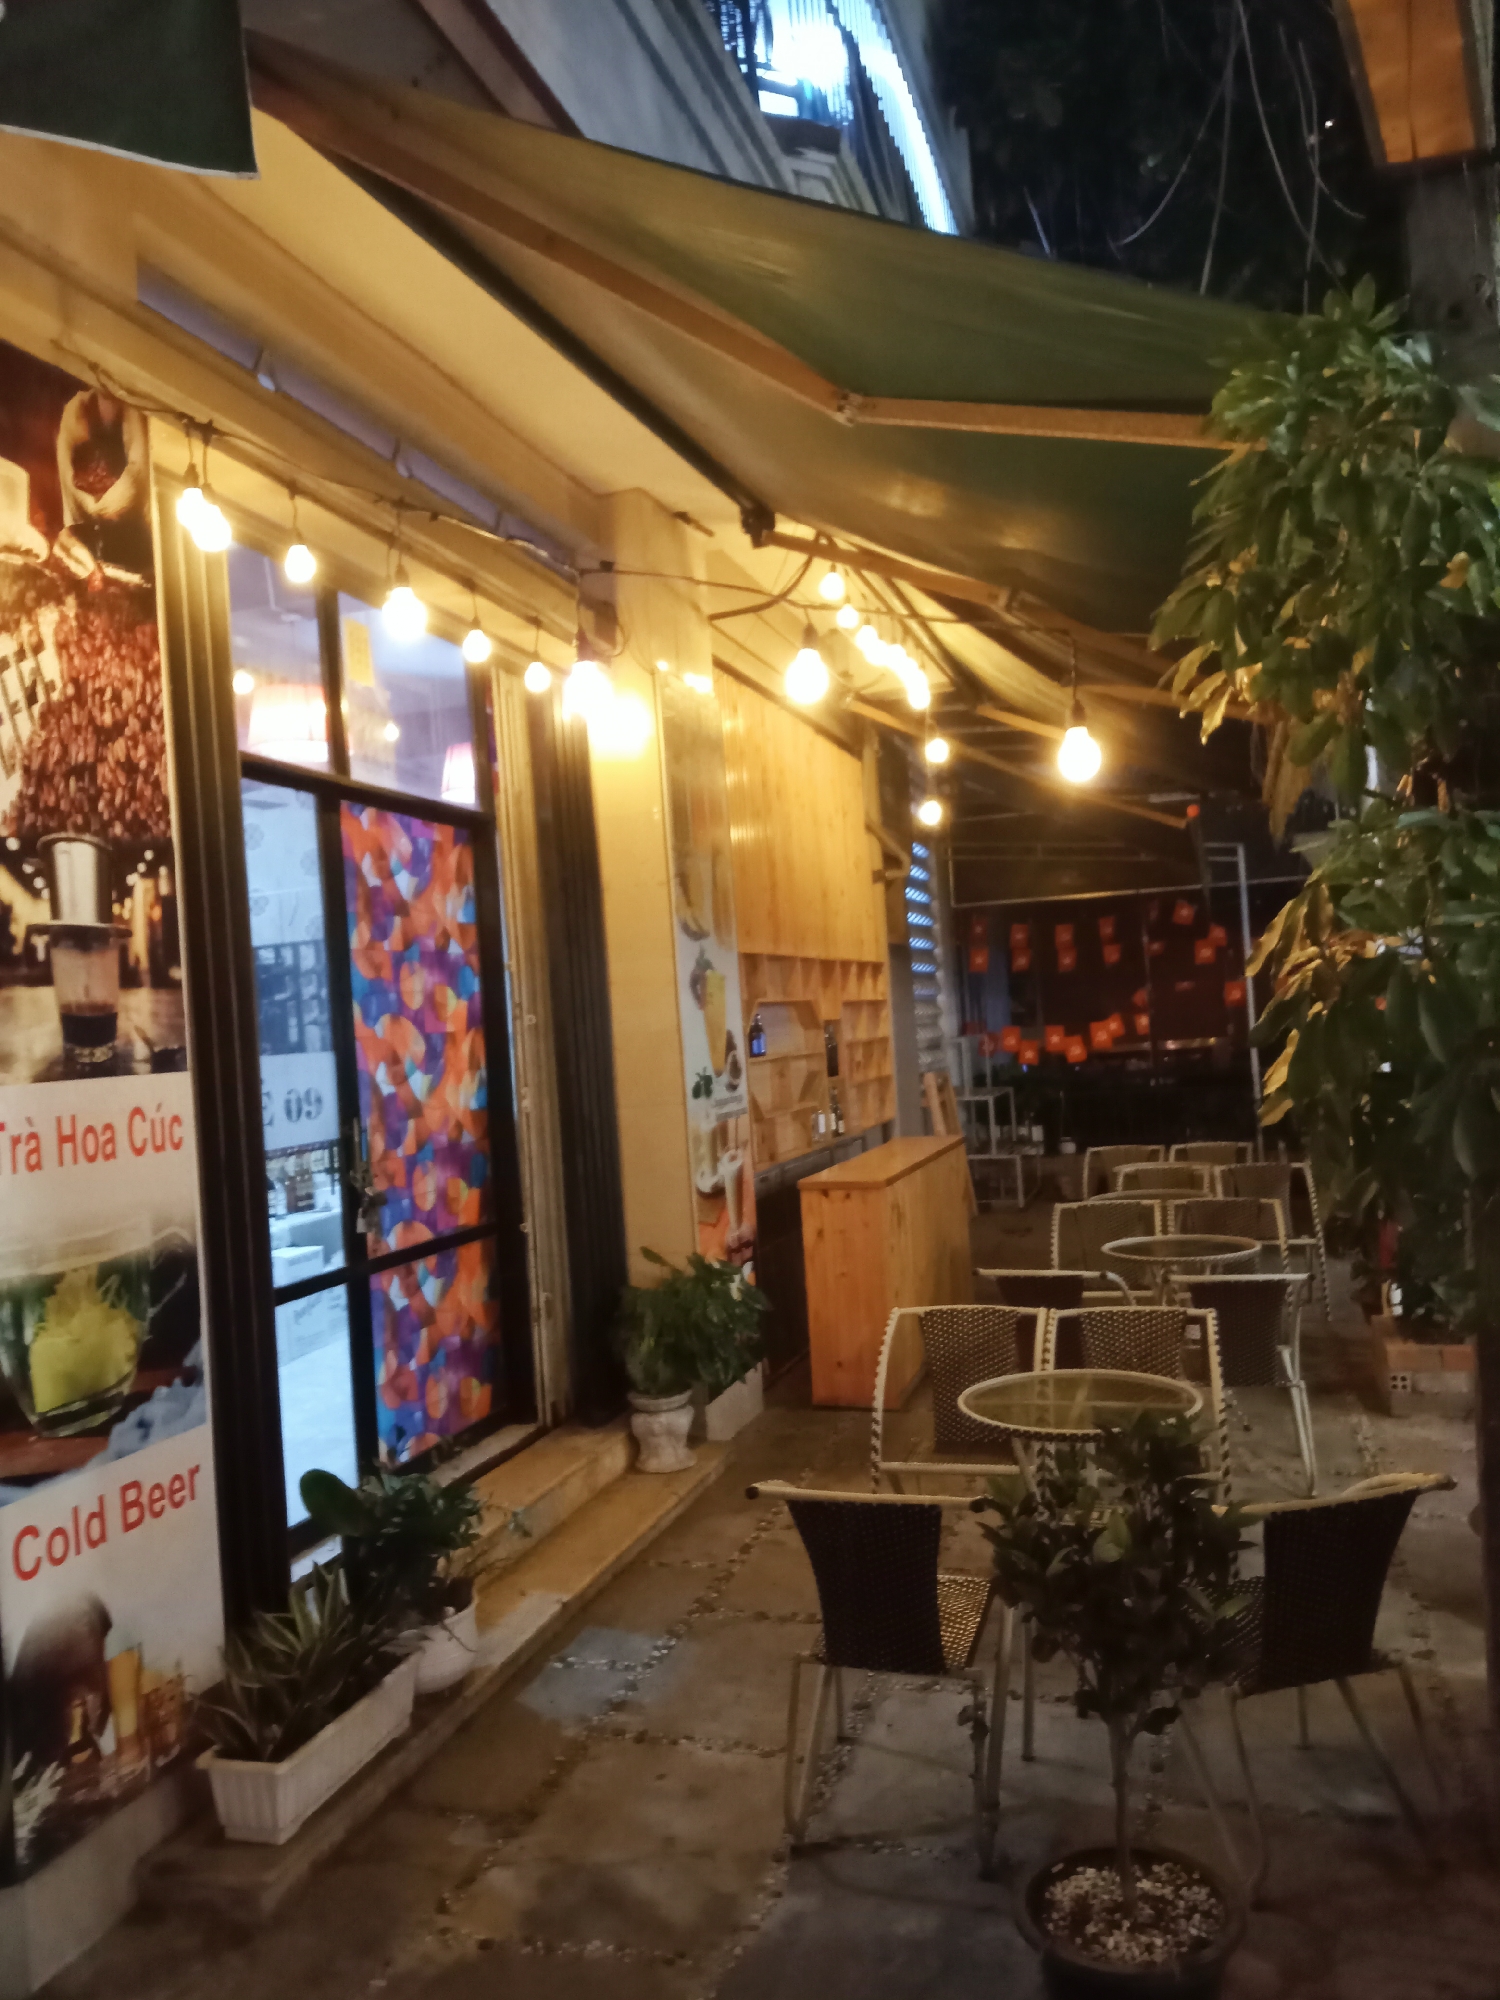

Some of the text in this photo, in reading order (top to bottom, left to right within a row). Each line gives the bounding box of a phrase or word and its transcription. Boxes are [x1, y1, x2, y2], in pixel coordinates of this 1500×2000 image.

[56, 1114, 116, 1167] Hoa
[128, 1102, 183, 1157] Cúc
[12, 1463, 200, 1581] Cold Beer
